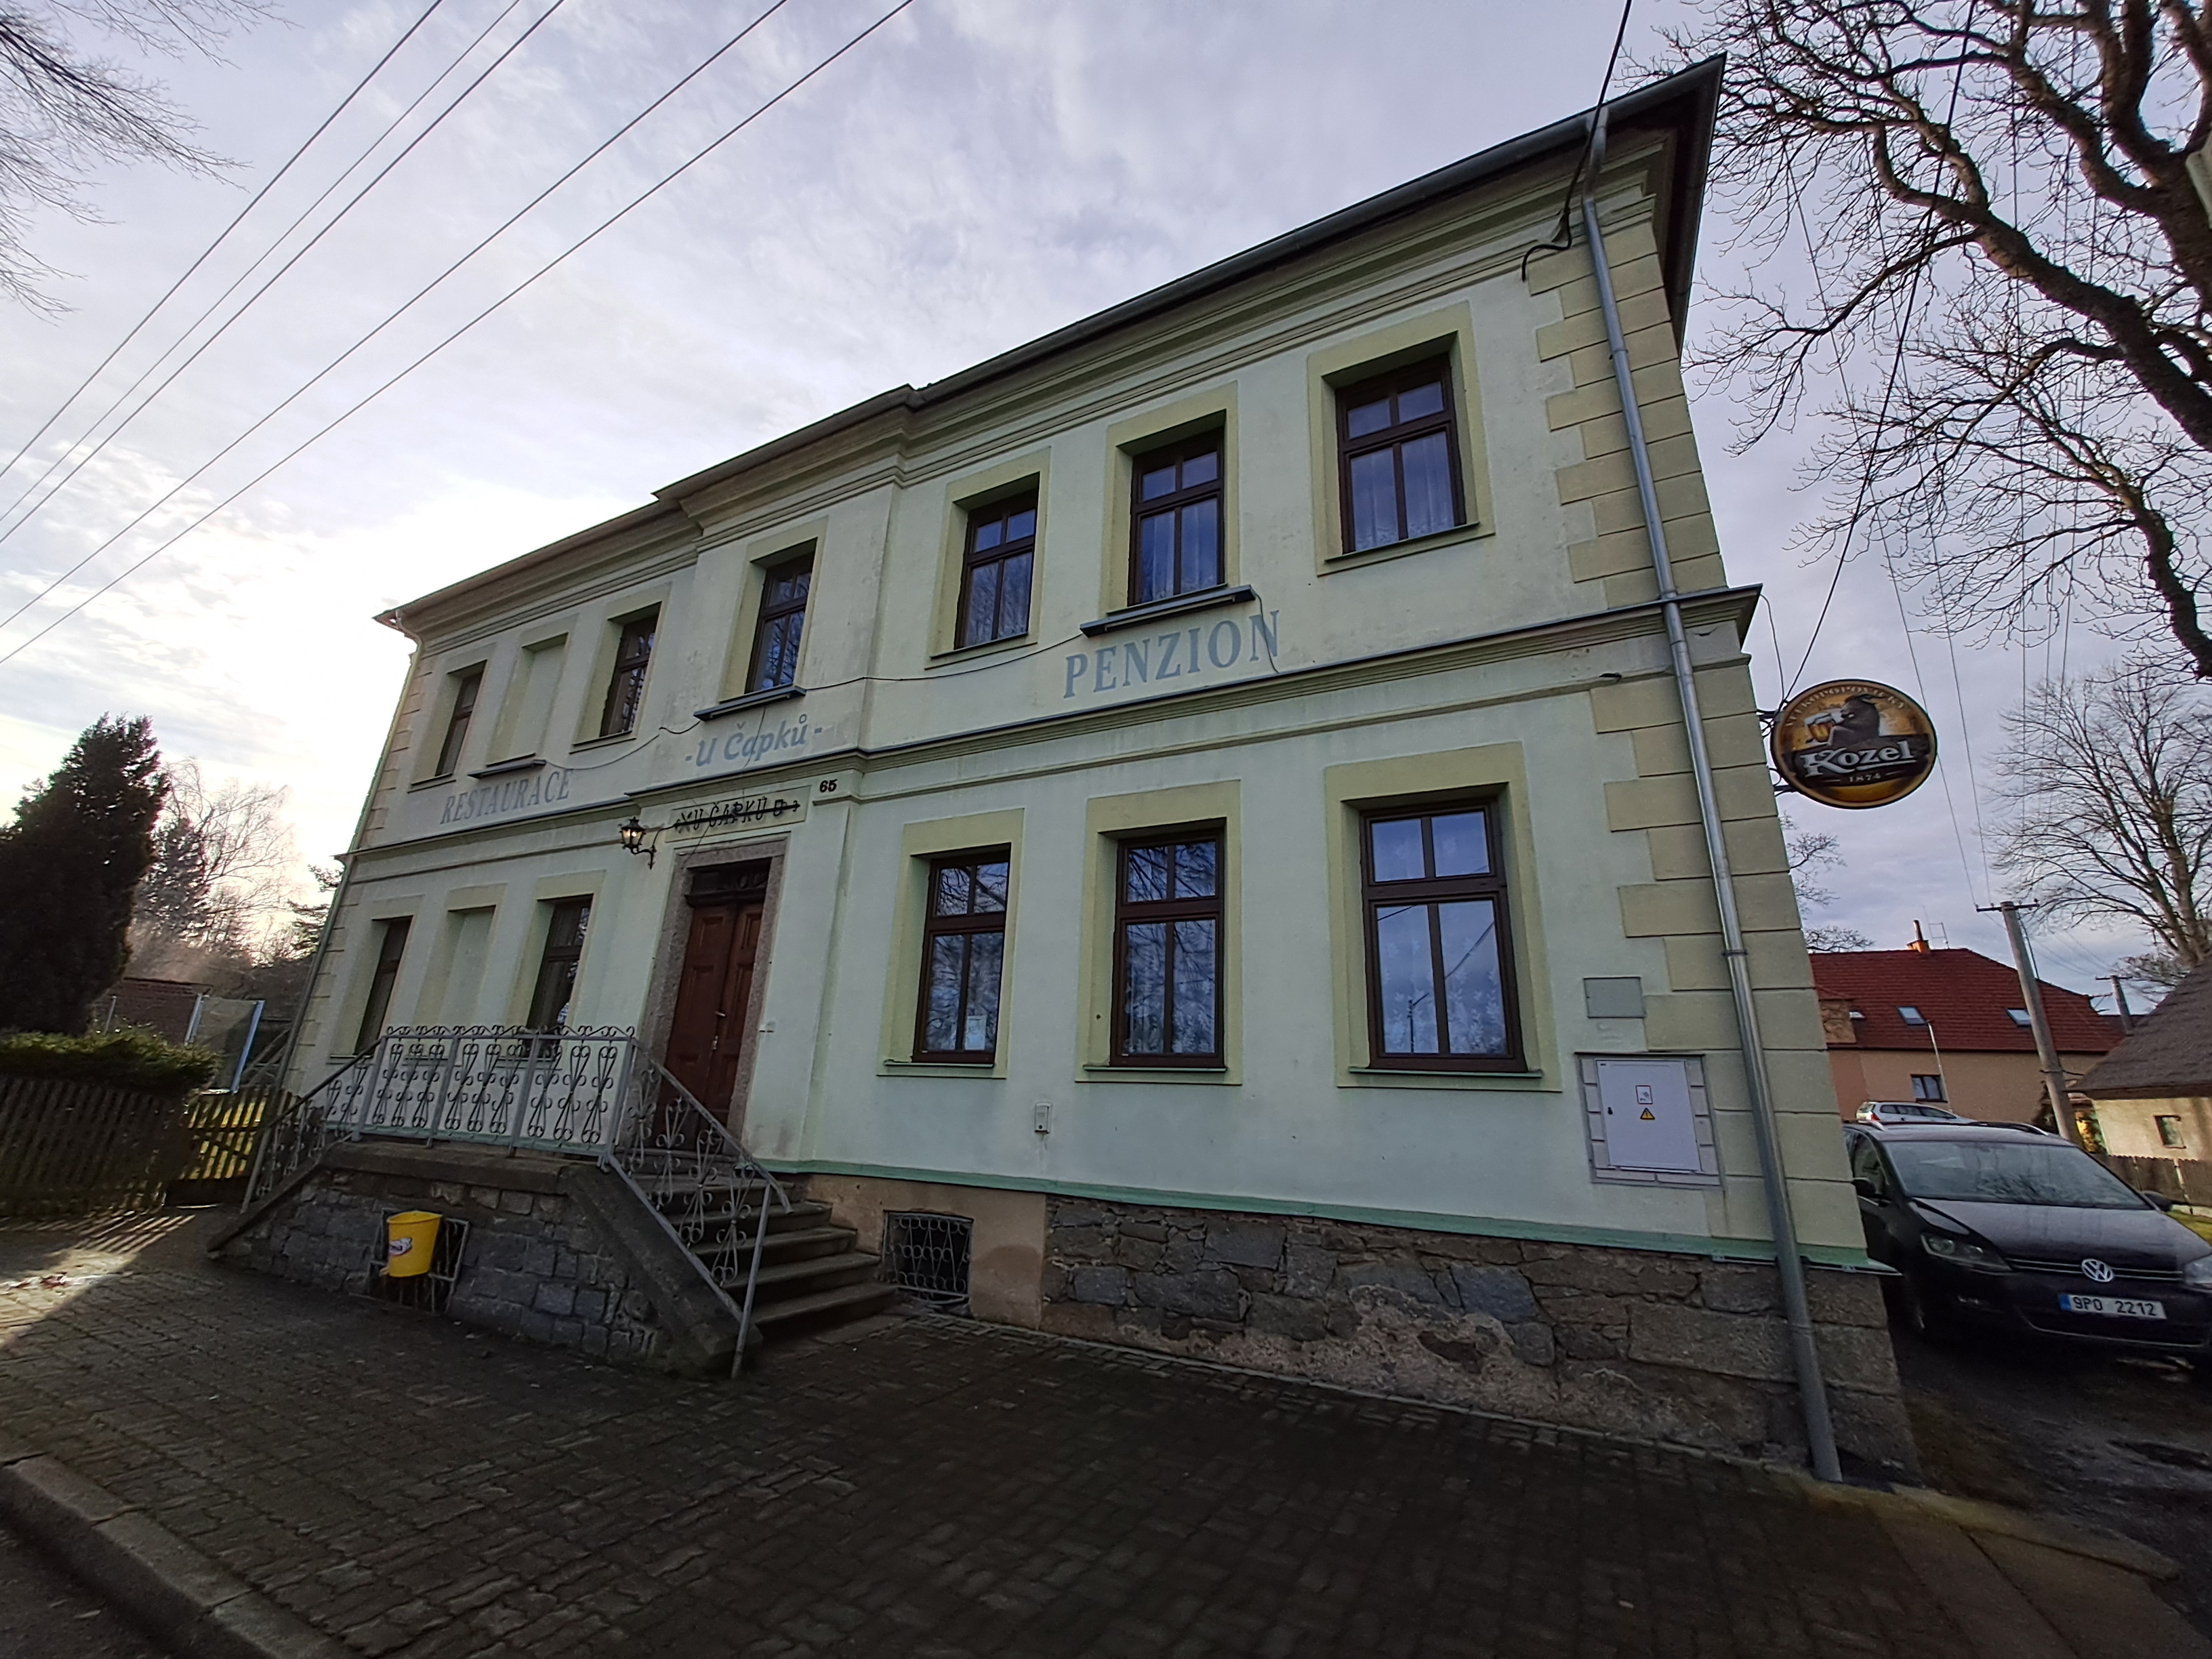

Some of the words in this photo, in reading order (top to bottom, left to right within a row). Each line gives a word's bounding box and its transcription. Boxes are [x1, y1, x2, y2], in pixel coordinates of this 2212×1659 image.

[1063, 610, 1279, 699] PENZION
[1800, 739, 1917, 778] Kozel
[440, 769, 573, 825] RESTAURACE
[819, 779, 838, 793] 65
[2114, 1300, 2158, 1317] 2212
